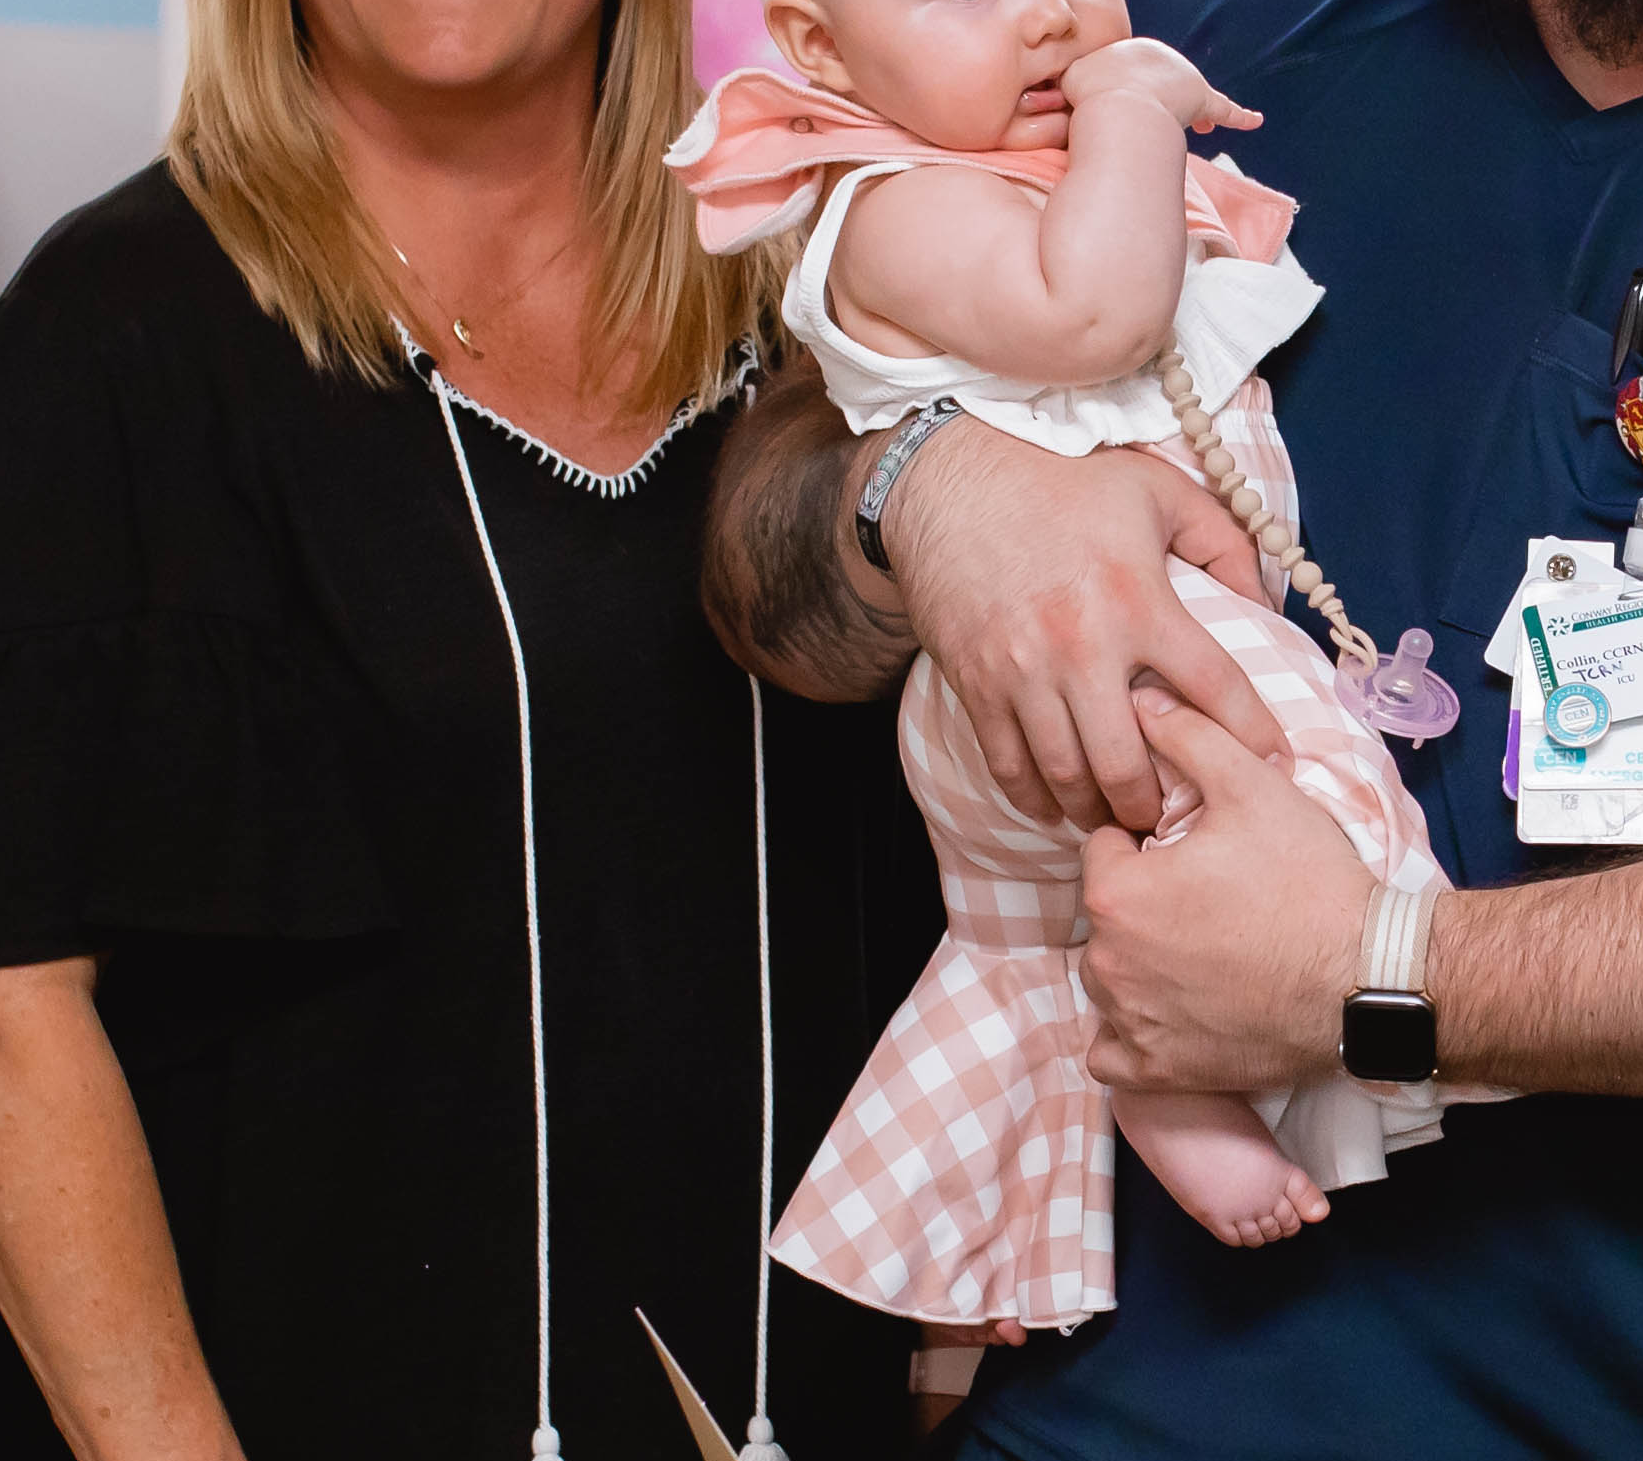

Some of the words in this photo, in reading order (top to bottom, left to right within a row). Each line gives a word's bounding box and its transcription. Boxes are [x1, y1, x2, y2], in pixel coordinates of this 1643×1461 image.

[1586, 616, 1618, 628] HEALTH
[1557, 655, 1600, 670] Collin,
[1617, 674, 1636, 684] ICU
[1565, 707, 1590, 721] CEN
[1543, 749, 1578, 765] CEN
